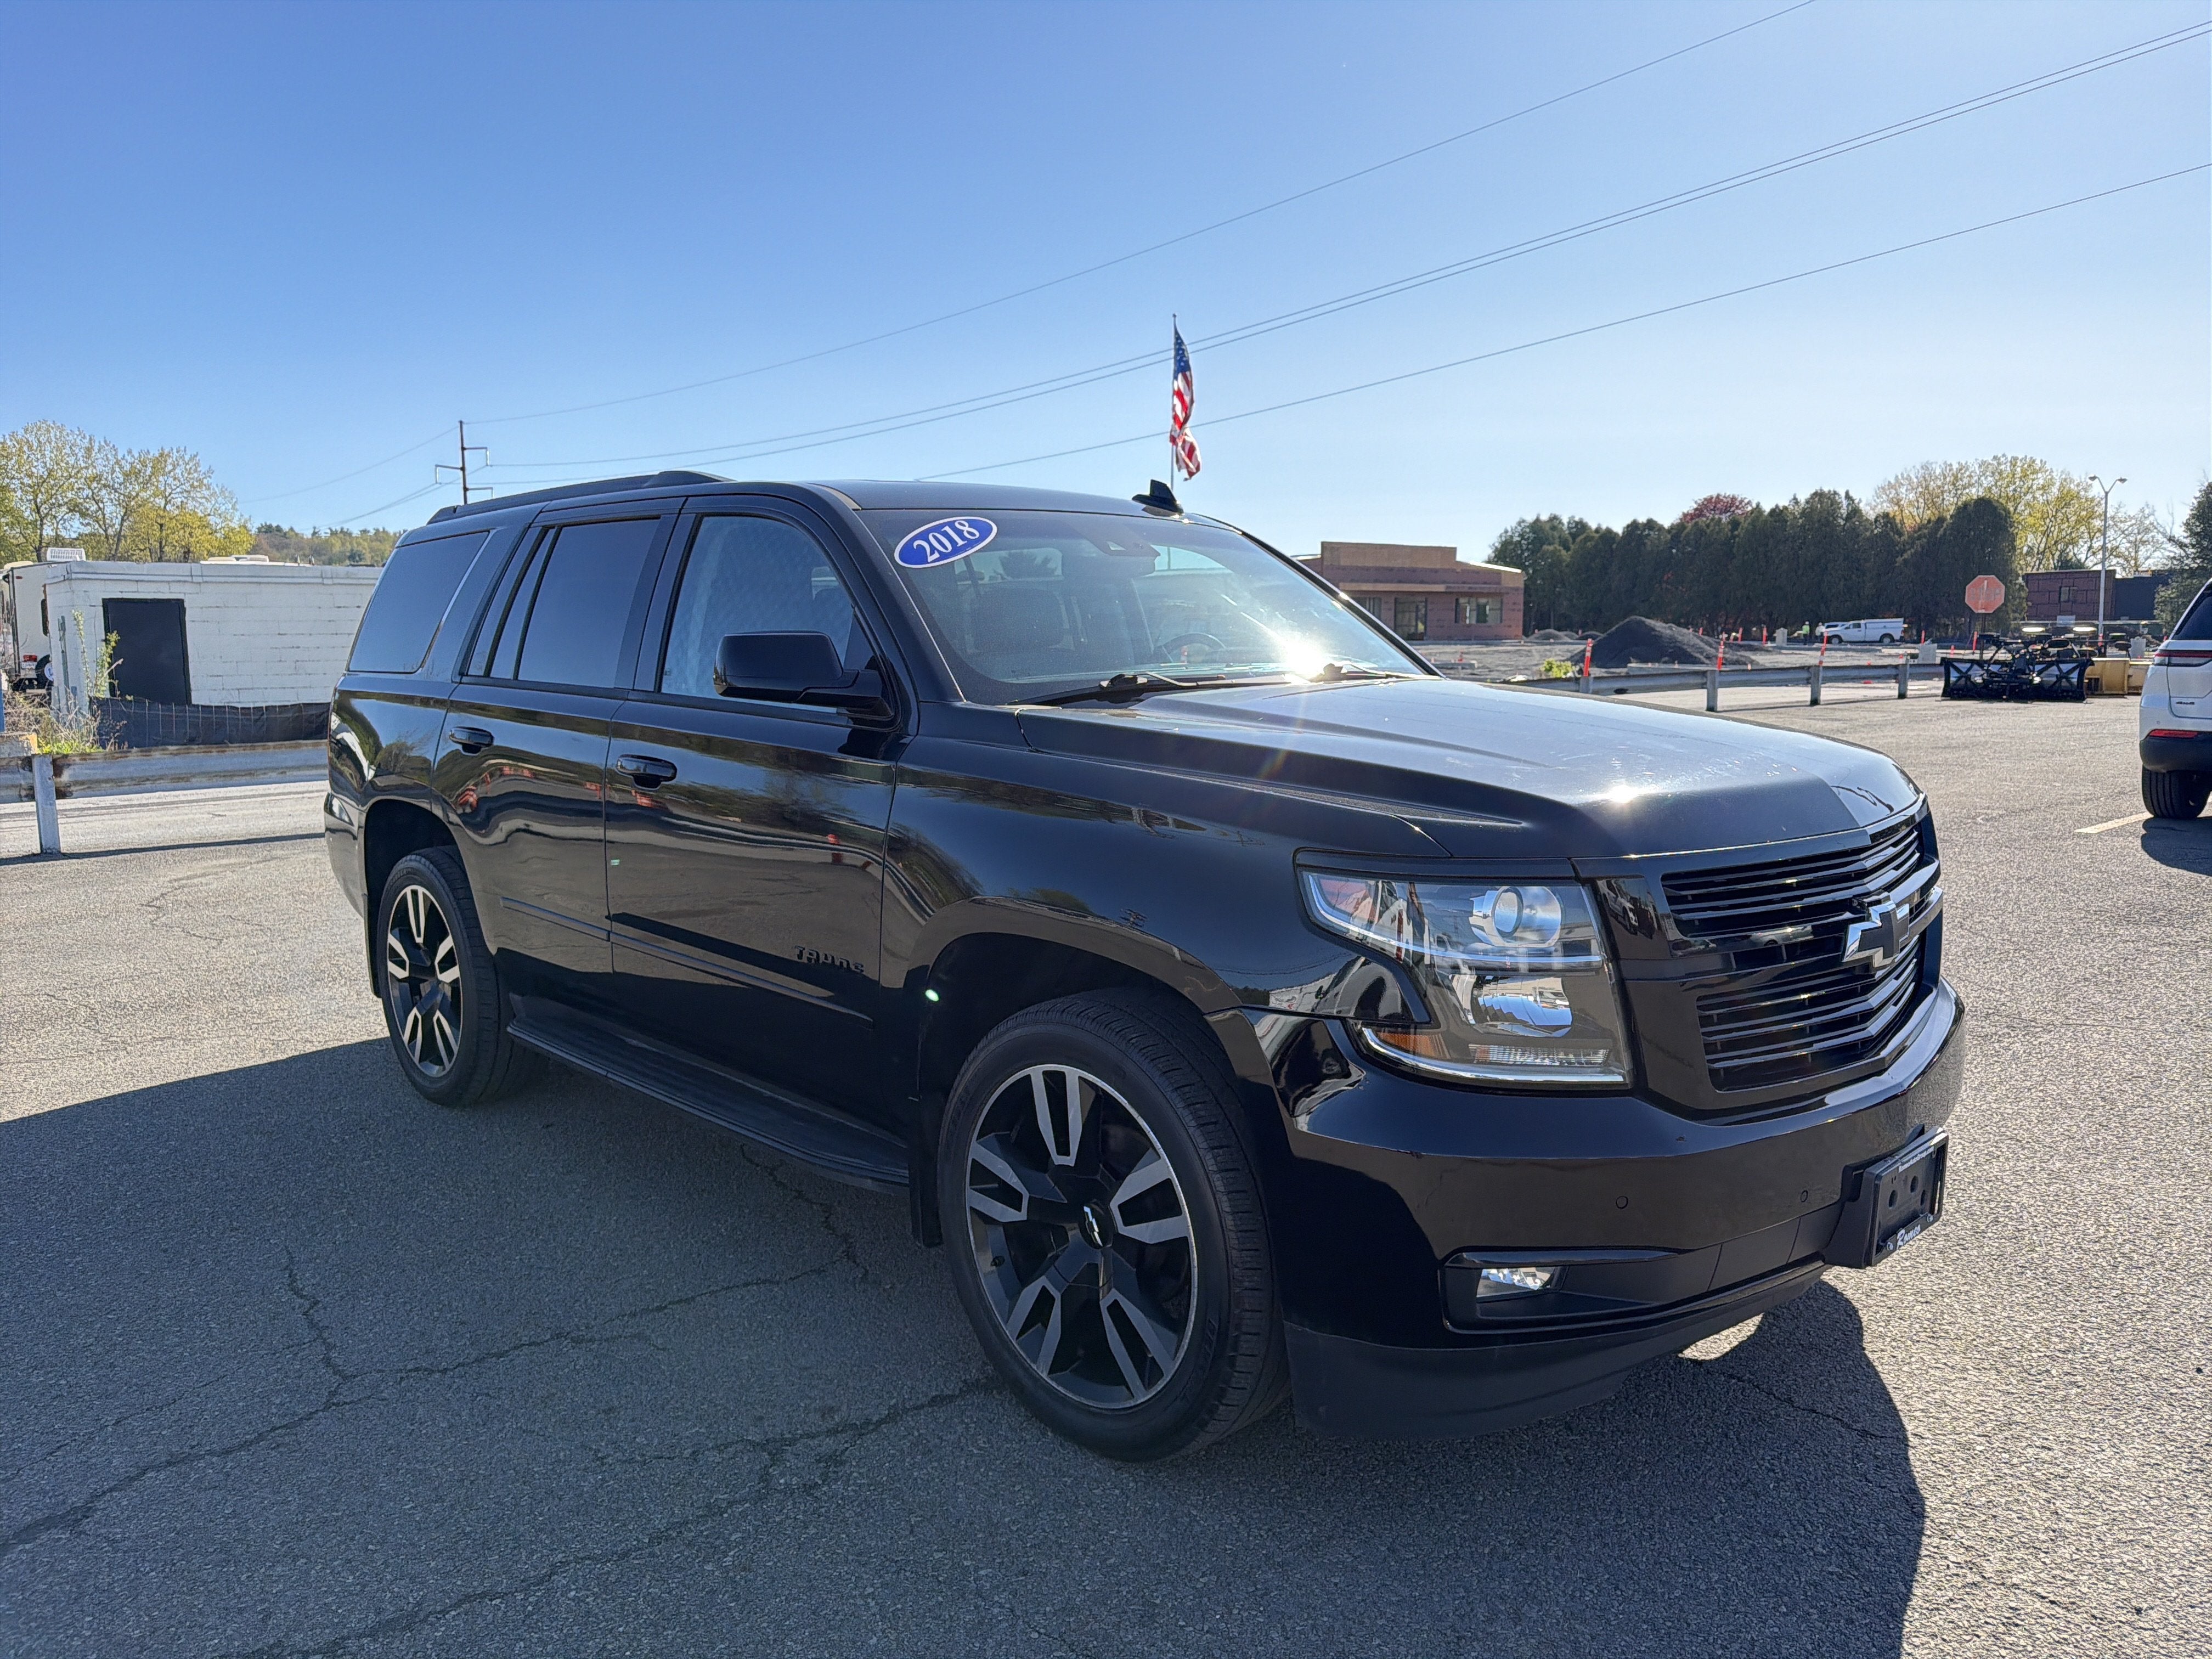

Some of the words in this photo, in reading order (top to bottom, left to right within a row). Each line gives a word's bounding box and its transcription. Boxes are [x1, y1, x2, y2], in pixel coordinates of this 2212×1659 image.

[913, 520, 980, 562] 2018
[1968, 588, 2002, 601] STOP
[1897, 1224, 1921, 1250] Romeo
